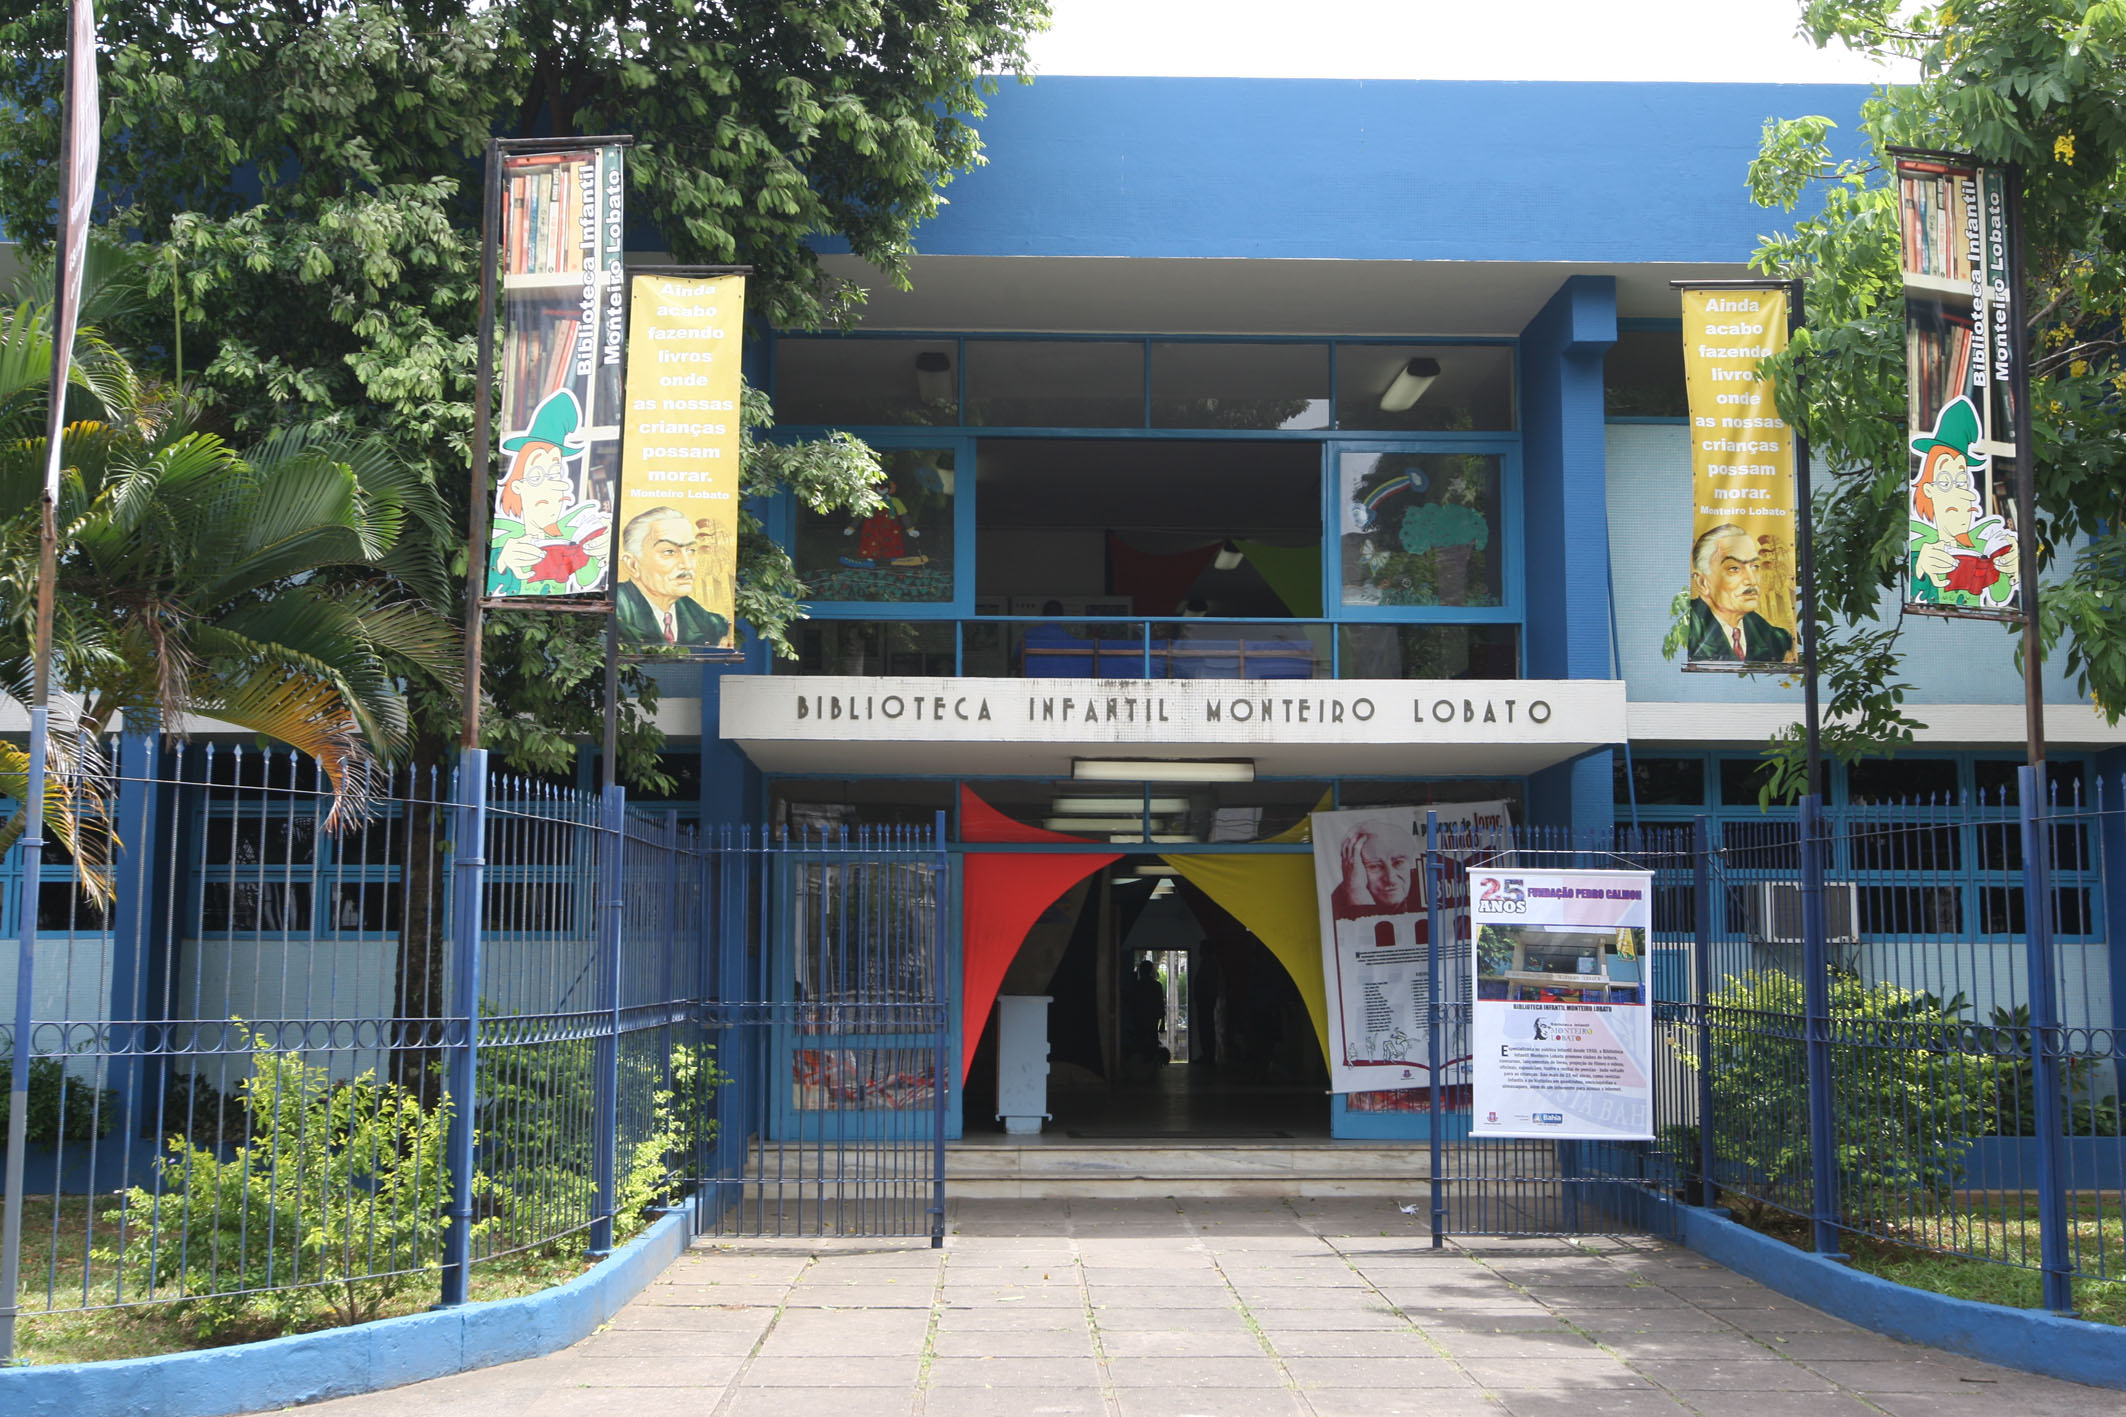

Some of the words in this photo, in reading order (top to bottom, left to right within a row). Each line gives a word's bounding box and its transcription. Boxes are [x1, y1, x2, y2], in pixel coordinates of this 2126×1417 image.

[578, 165, 595, 249] Infantil
[605, 170, 621, 253] Lobato
[1961, 180, 1981, 261] Infantil
[1988, 192, 2004, 271] Lobato
[660, 283, 717, 297] Ainda
[604, 260, 622, 364] Monteiro
[656, 304, 718, 317] acabo
[1705, 298, 1760, 313] Ainda
[577, 257, 595, 375] Biblioteca
[647, 325, 725, 340] fazendo
[1705, 322, 1763, 335] acabo
[1971, 270, 1986, 387] Biblioteca
[1992, 279, 2009, 381] Monteiro
[657, 349, 713, 363] livros
[1698, 345, 1773, 358] fazendo
[659, 373, 709, 386] onde
[1711, 367, 1760, 381] livro
[633, 399, 657, 410] as
[663, 399, 734, 411] nossas
[1716, 392, 1761, 405] onde
[639, 420, 727, 437] crianças
[1695, 416, 1716, 428] as
[1721, 417, 1785, 429] nossas
[1702, 438, 1779, 454] crianças
[642, 446, 720, 461] possam
[647, 470, 713, 482] morar.
[1708, 464, 1776, 477] possam
[630, 488, 684, 498] Monteiro
[687, 489, 731, 500] Lobato
[1714, 488, 1771, 499] morar.
[1700, 505, 1746, 515] Monteiro
[1749, 506, 1787, 516] Lobato
[796, 694, 993, 721] BIBLIOTECA
[1029, 696, 1169, 723] INFANTIL
[1206, 697, 1376, 723] MONTEIRO
[1414, 699, 1552, 724] LOBATO
[1480, 877, 1525, 901] 25
[1527, 886, 1574, 900] FUNDAÇÃO
[1575, 888, 1604, 900] PEDRO
[1478, 900, 1527, 914] ANOS
[1513, 1003, 1543, 1011] BIBLIOTECA
